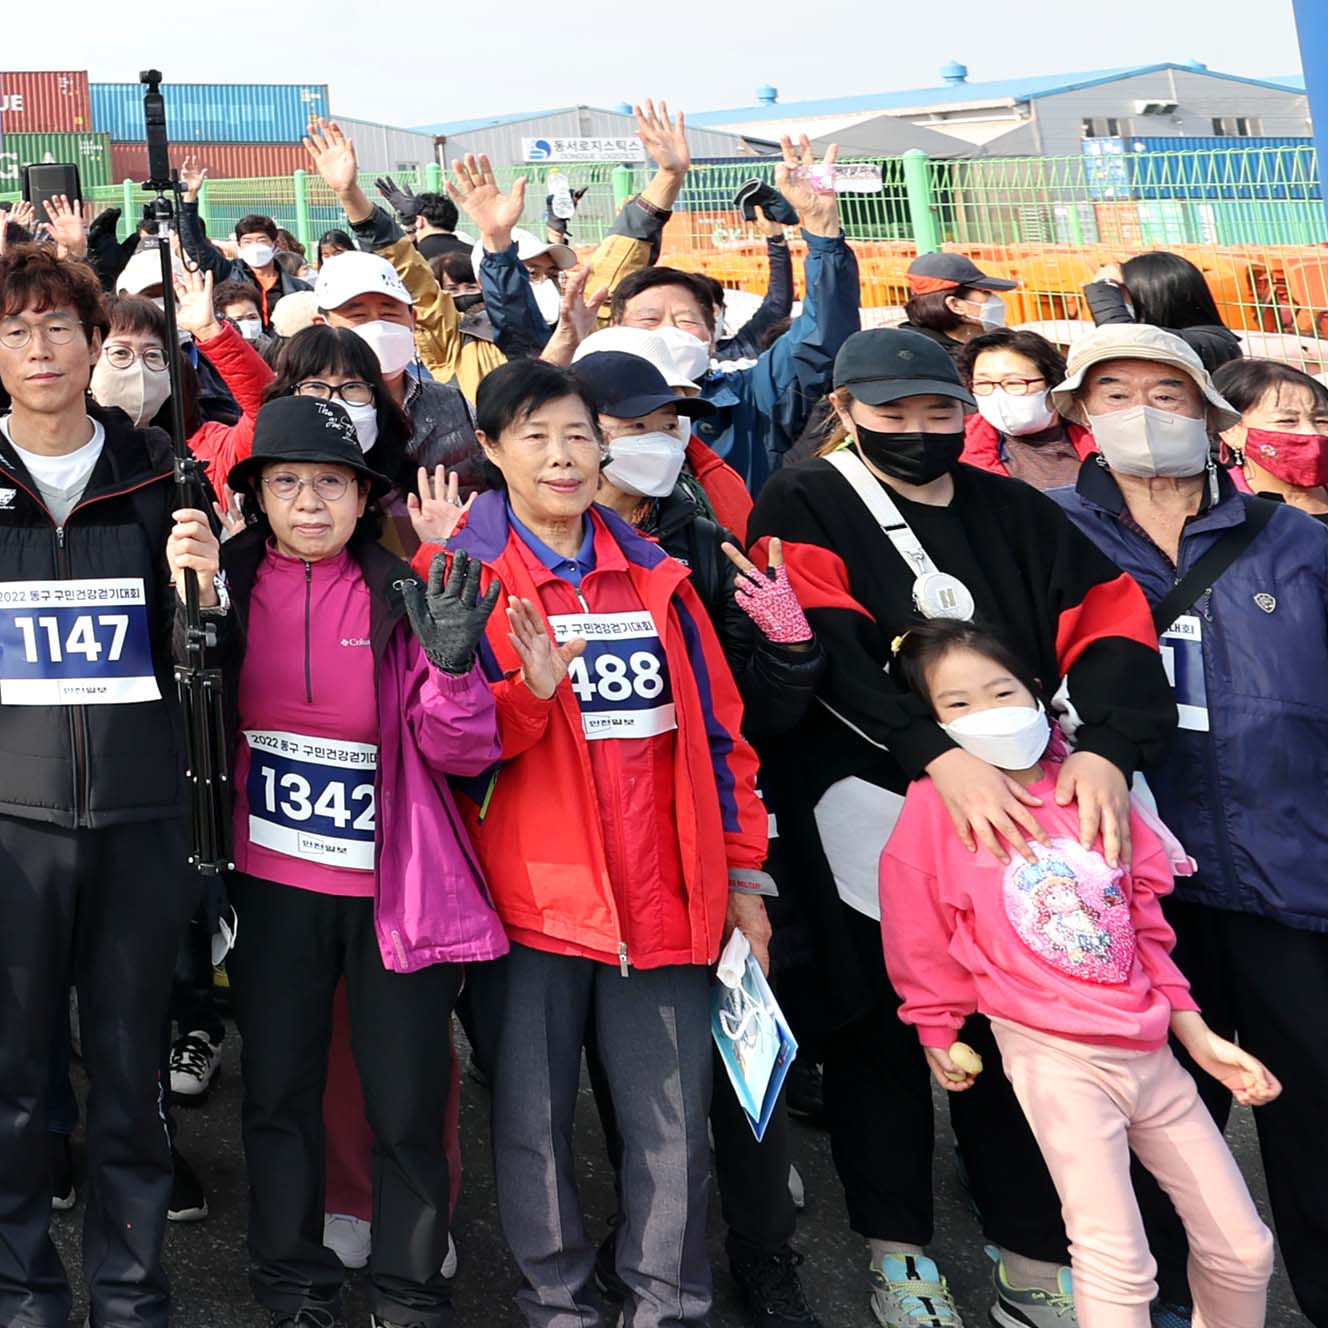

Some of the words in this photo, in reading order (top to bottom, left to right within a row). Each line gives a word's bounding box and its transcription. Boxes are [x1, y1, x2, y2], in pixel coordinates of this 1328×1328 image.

[554, 139, 640, 153] 동서로지스틱스
[30, 590, 52, 601] 동구
[54, 587, 141, 601] 구민건강걷기대회
[571, 621, 654, 635] 구민건강걷기대회
[14, 614, 129, 663] 1147
[567, 651, 664, 702] 488
[251, 734, 279, 749] 2022
[281, 740, 299, 754] 동구
[261, 766, 376, 831] 1342
